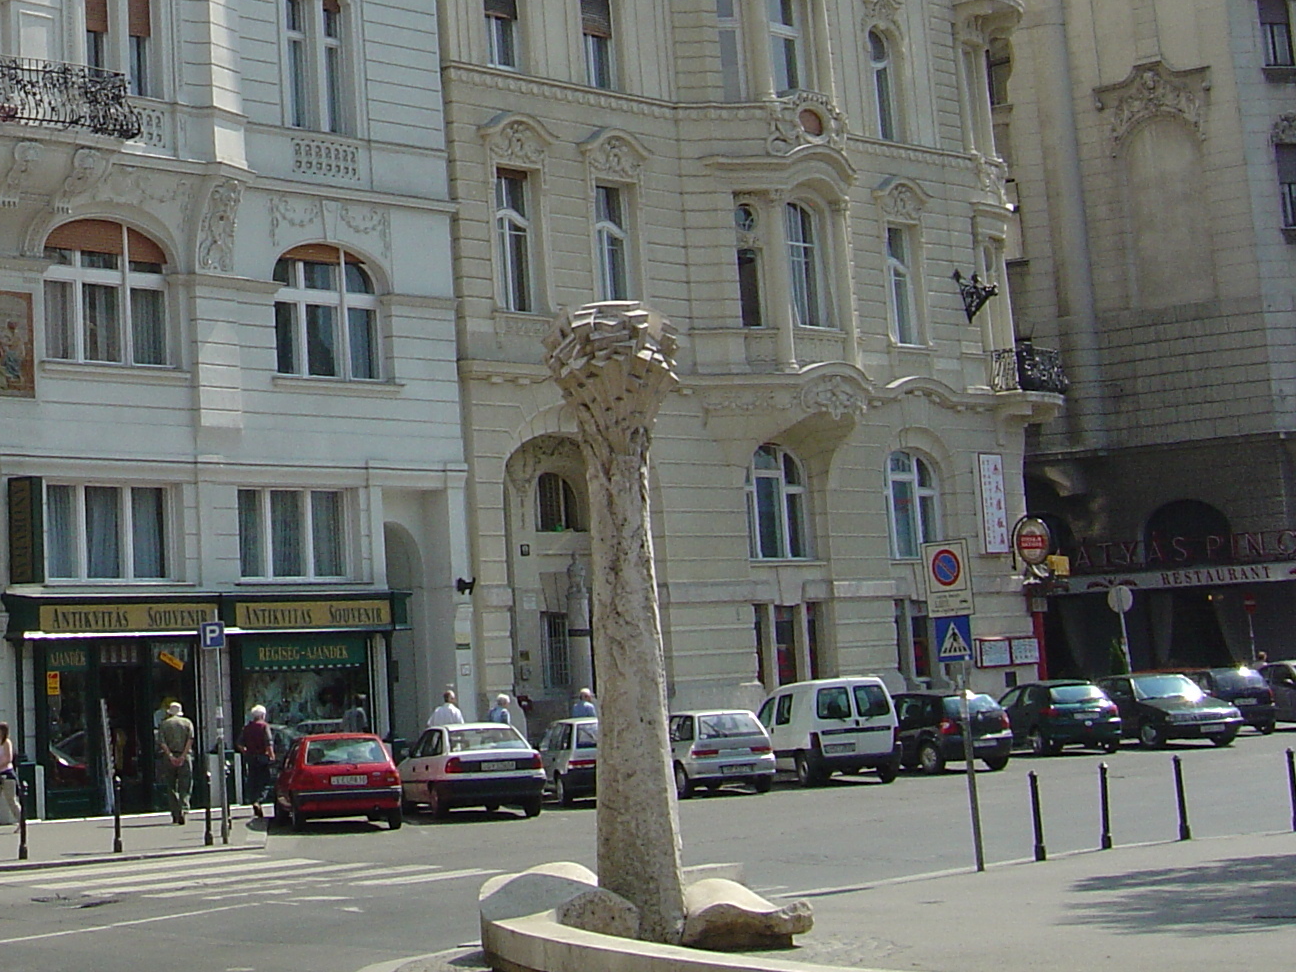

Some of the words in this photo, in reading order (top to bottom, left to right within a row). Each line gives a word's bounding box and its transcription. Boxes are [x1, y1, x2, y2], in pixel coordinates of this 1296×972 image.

[1160, 565, 1271, 586] RESTAURANT
[53, 607, 129, 629] ANTIKVITÁS
[147, 606, 207, 627] SOUVENIR
[328, 604, 383, 624] SOUVENIR
[206, 626, 219, 645] P
